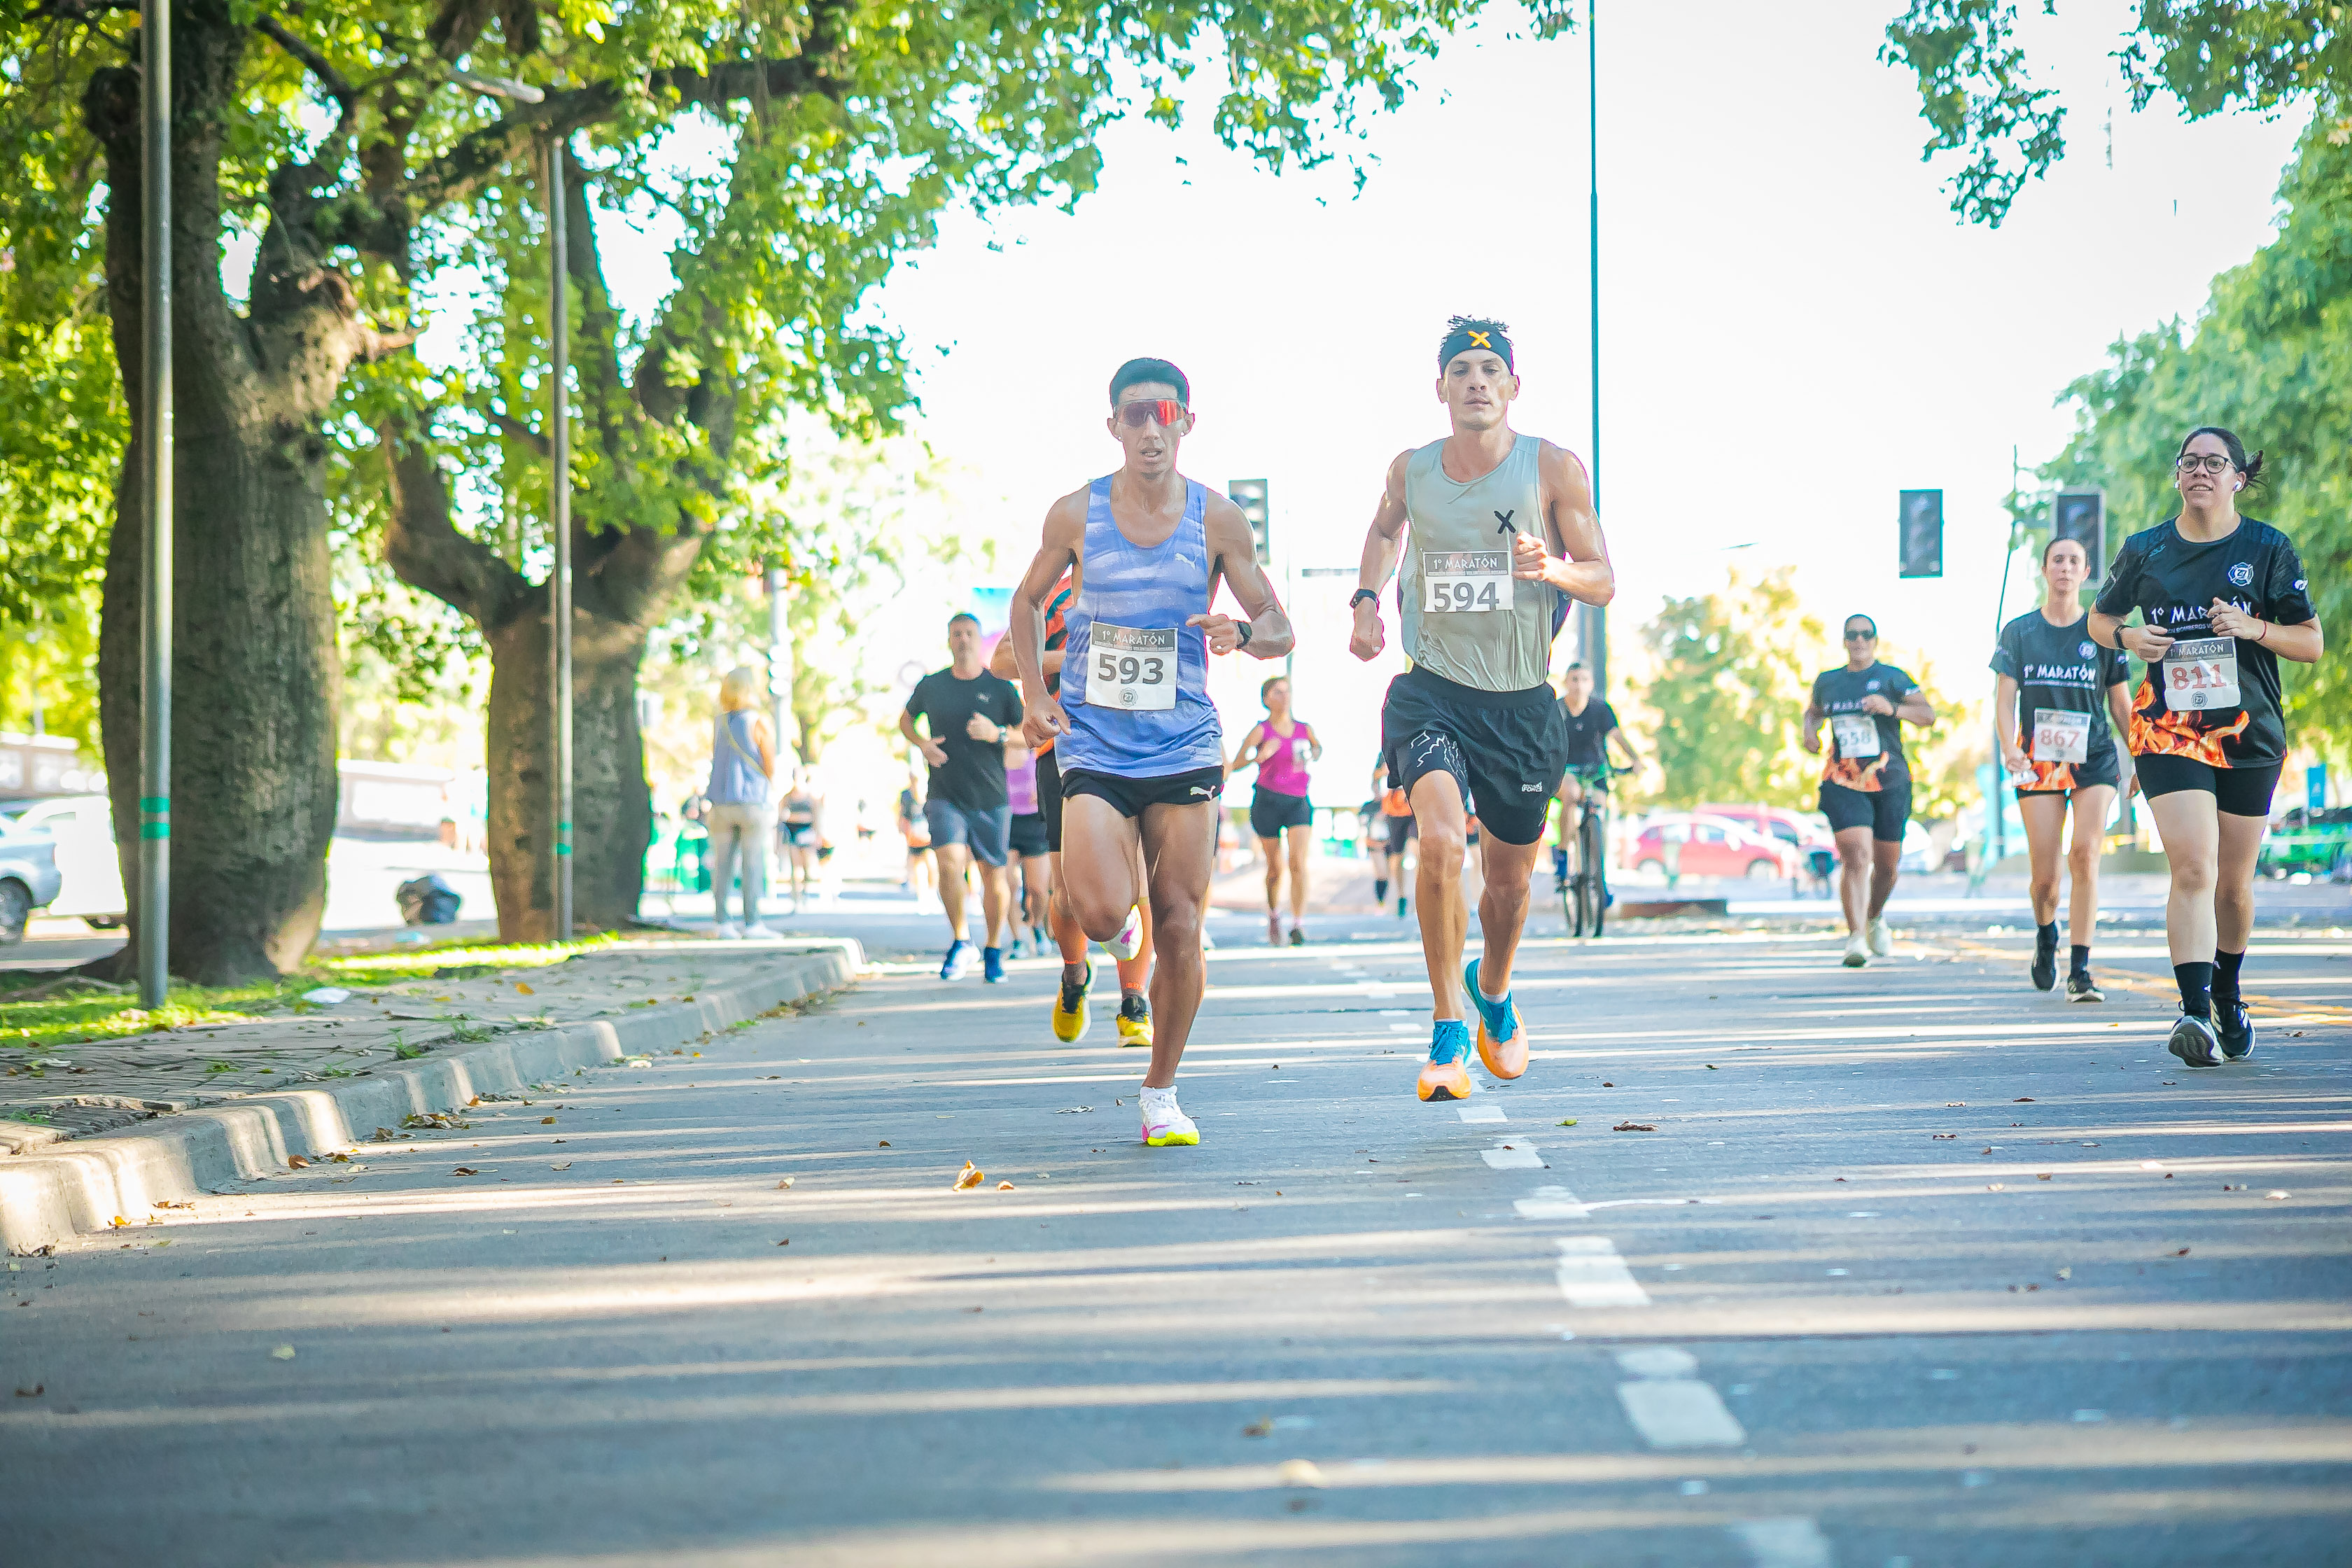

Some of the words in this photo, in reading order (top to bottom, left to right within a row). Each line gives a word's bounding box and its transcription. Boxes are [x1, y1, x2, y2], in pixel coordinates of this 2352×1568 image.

[1445, 554, 1498, 569] MARATÓN
[1434, 582, 1499, 612] 594
[2171, 596, 2252, 623] MARÓN
[1113, 632, 1166, 645] MARATÓN
[2178, 642, 2224, 656] MARATÓN
[1098, 653, 1163, 685] 593
[2036, 663, 2096, 681] MARATÓN
[2171, 664, 2227, 690] 811
[2040, 729, 2080, 748] 867
